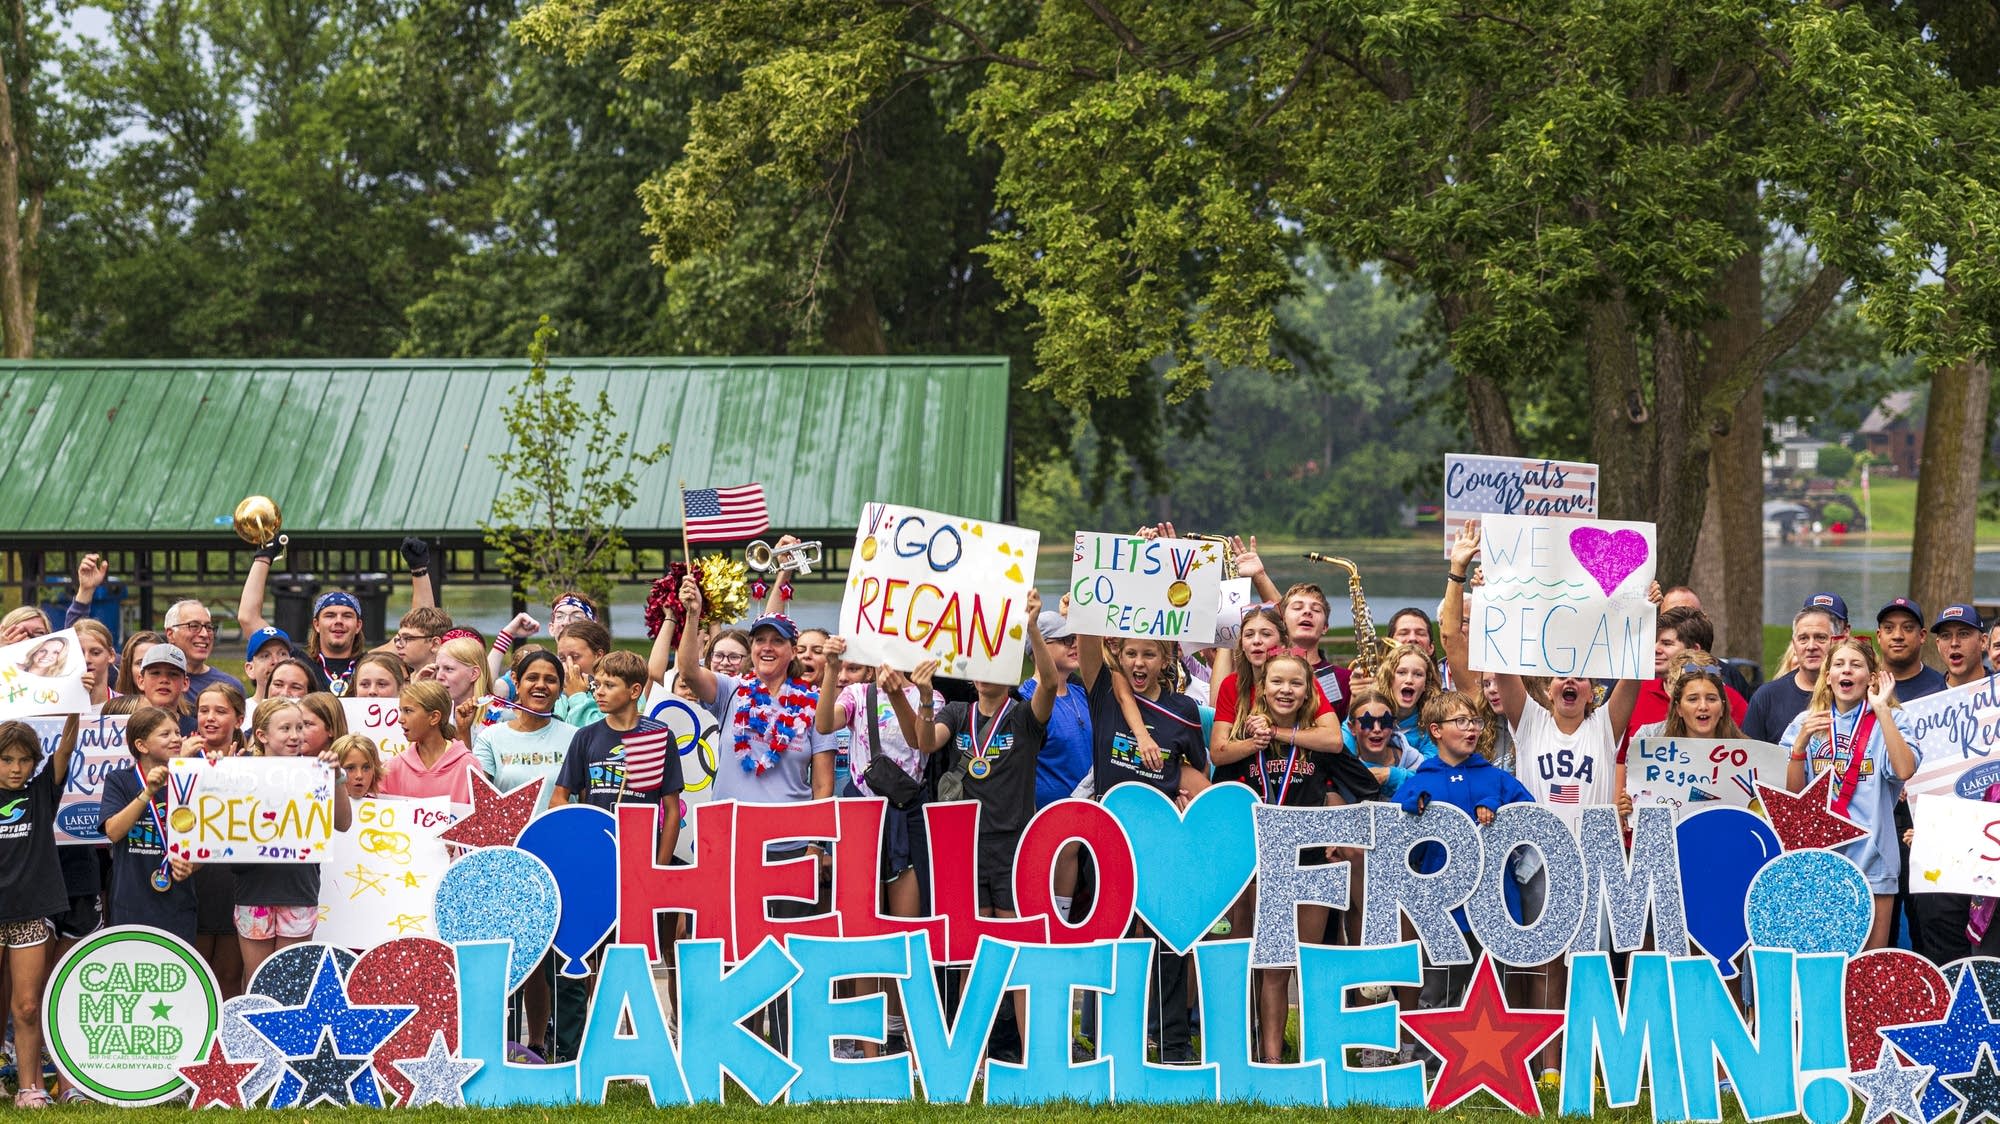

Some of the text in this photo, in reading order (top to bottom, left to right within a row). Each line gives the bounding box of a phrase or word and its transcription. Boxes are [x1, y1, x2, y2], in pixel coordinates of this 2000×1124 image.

[1446, 461, 1569, 503] Congrats
[1503, 481, 1596, 516] Regan!
[894, 516, 962, 572] GO
[1074, 534, 1085, 562] USA
[1094, 537, 1162, 575] LETS
[1484, 527, 1550, 568] WE
[1073, 575, 1114, 606] GO
[856, 576, 1012, 661] REGAN
[1105, 604, 1190, 637] REGAN!
[1484, 604, 1642, 679] REGAN
[364, 704, 399, 727] go
[1537, 749, 1594, 784] USA
[1639, 739, 1691, 764] Lets
[1646, 765, 1718, 788] Regan!
[199, 795, 333, 843] REGAN
[359, 802, 395, 828] GO
[257, 845, 297, 860] 2024
[617, 797, 1689, 968] HELLO FROM
[79, 962, 188, 993] CARD
[79, 993, 142, 1024] MY
[80, 1024, 184, 1055] YARD
[453, 930, 1853, 1123] LAKEVILLE MN!
